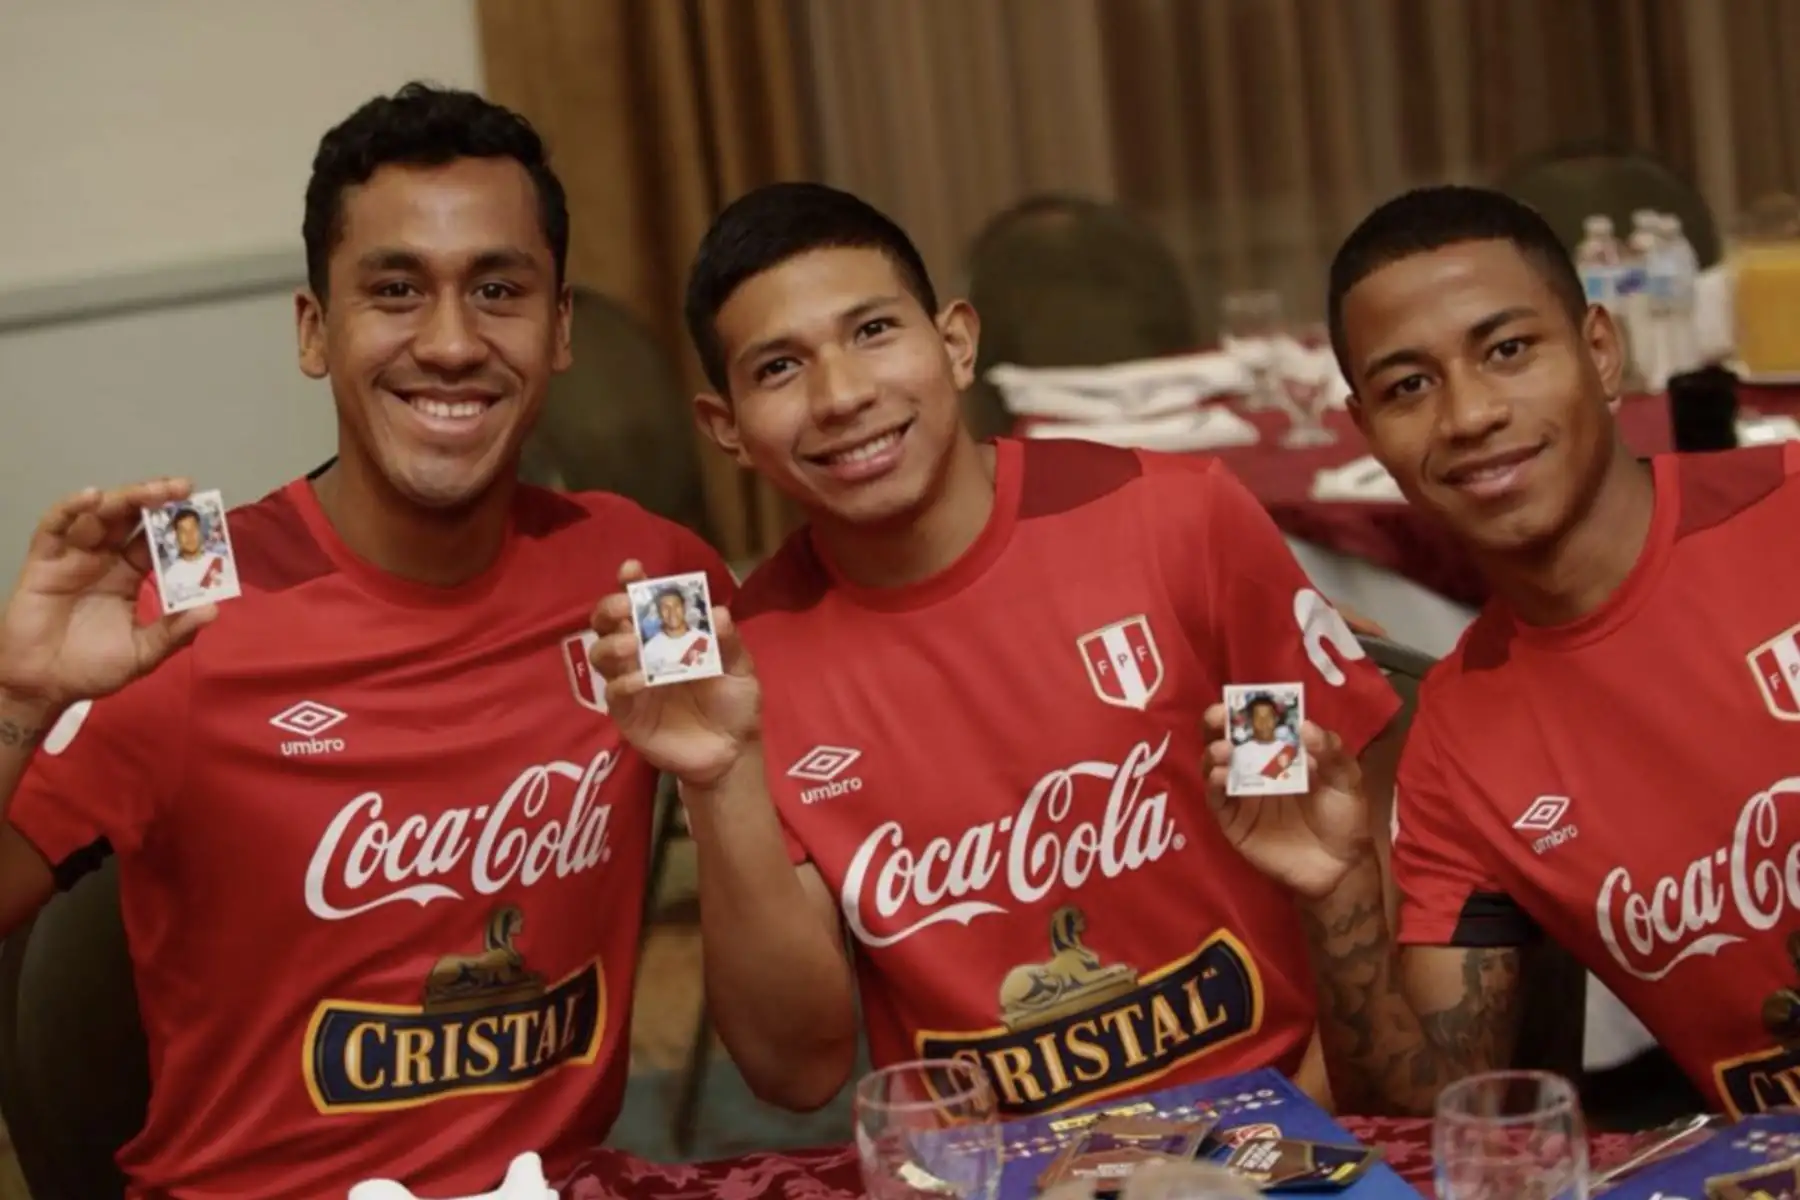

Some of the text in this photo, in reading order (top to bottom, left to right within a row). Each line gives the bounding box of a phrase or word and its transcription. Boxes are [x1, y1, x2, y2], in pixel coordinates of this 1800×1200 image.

[280, 737, 345, 756] umbro
[800, 777, 862, 804] umbro
[304, 749, 619, 920] Coca-Cola
[842, 731, 1174, 947] Coca-Cola
[1532, 824, 1578, 855] umbro
[344, 996, 577, 1090] CRISTAL
